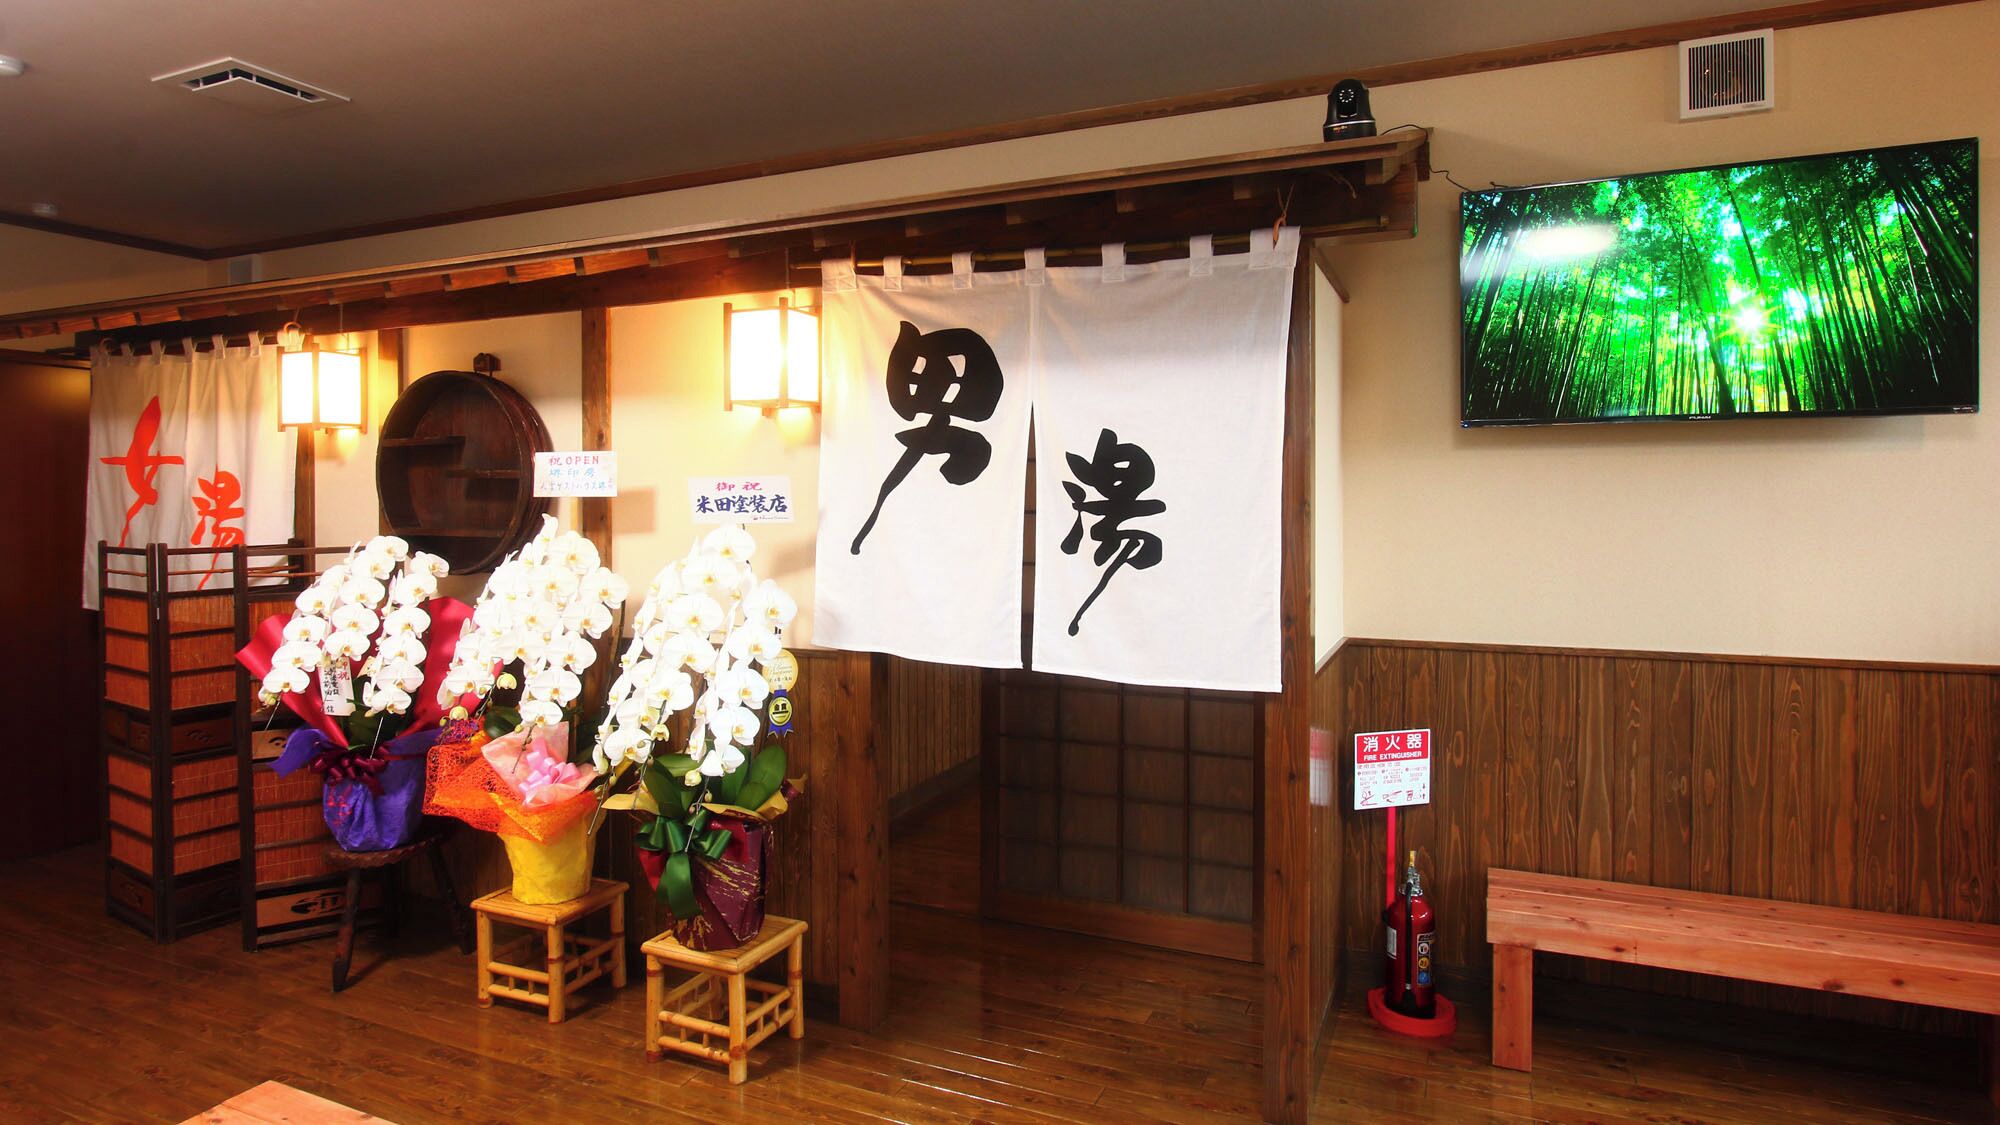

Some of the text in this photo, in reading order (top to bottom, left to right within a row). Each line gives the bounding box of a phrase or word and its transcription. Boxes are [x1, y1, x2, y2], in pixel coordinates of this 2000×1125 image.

[696, 494, 788, 514] 米田塗装店
[1363, 733, 1422, 752] 消火器
[1379, 751, 1422, 760] EXTINGUISHER
